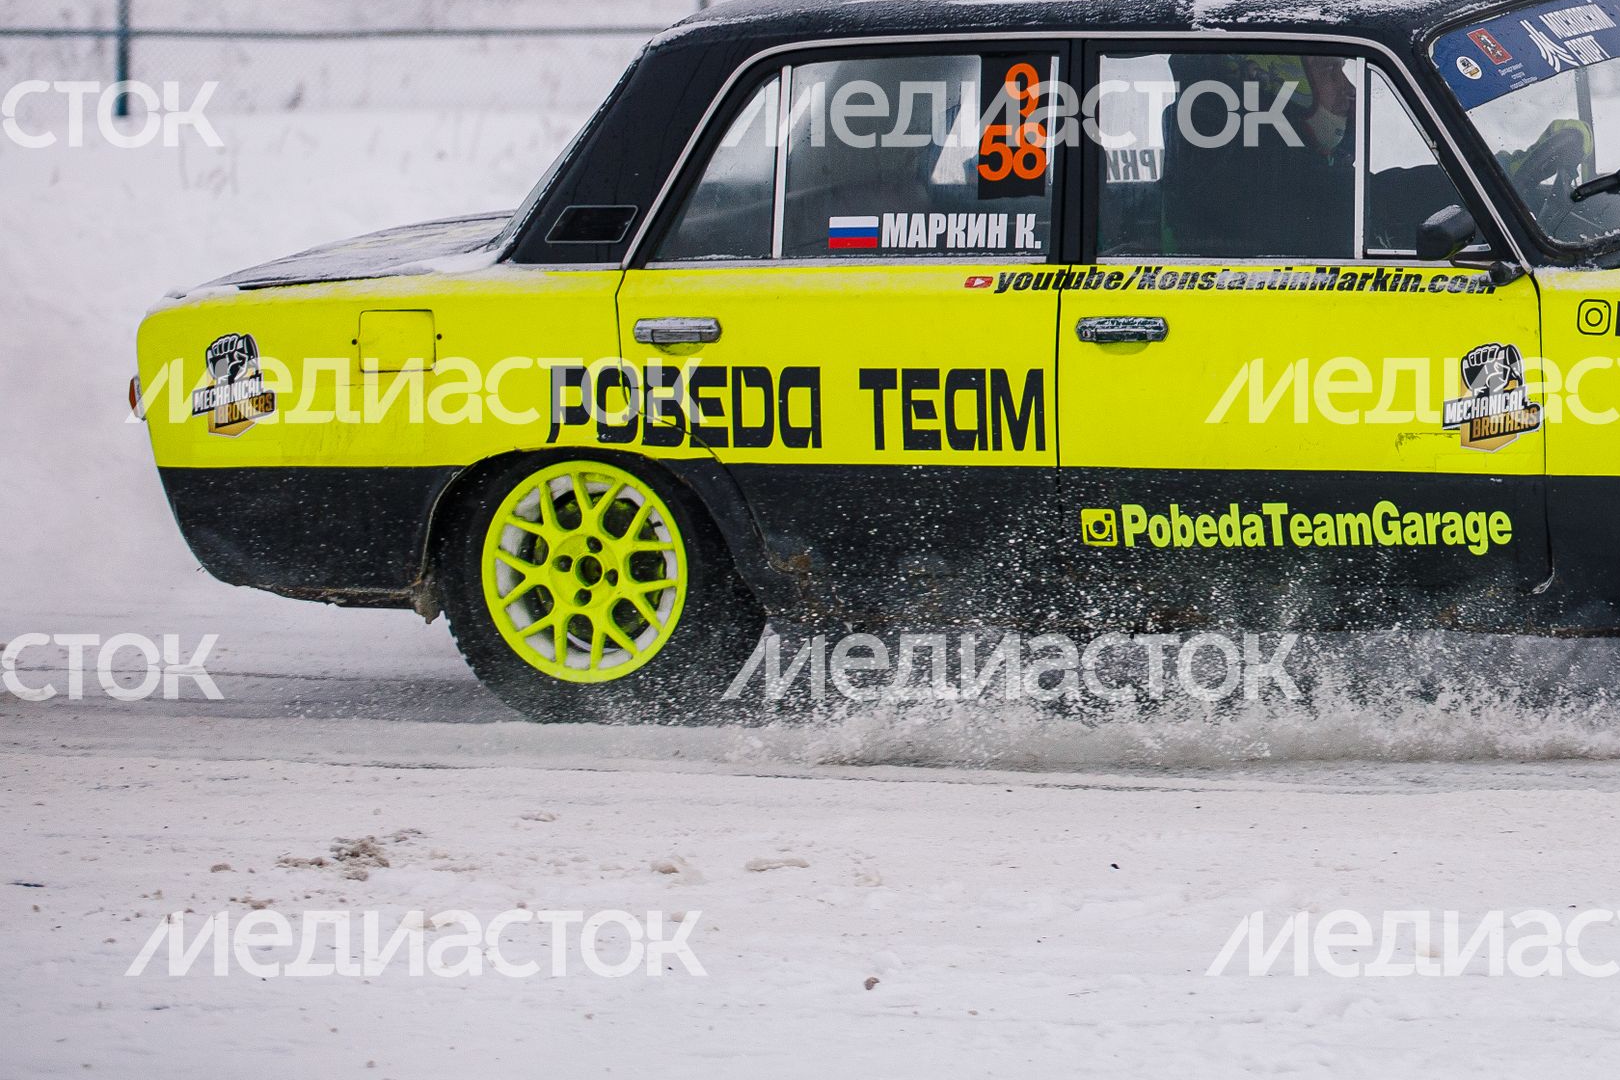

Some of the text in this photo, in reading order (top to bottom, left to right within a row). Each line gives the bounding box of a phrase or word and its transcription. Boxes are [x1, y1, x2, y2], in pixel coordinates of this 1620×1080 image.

[1564, 35, 1611, 65] СПОРТ
[1005, 63, 1040, 118] 9
[976, 122, 1047, 181] 58
[881, 213, 1042, 249] МАРКИН К.
[194, 376, 264, 413] MECHANICAL
[217, 392, 274, 425] BROTHERS
[1445, 389, 1526, 424] MECHANICAL
[1471, 406, 1539, 439] BROTHERS
[1120, 500, 1512, 556] PobedaTeamGarage
